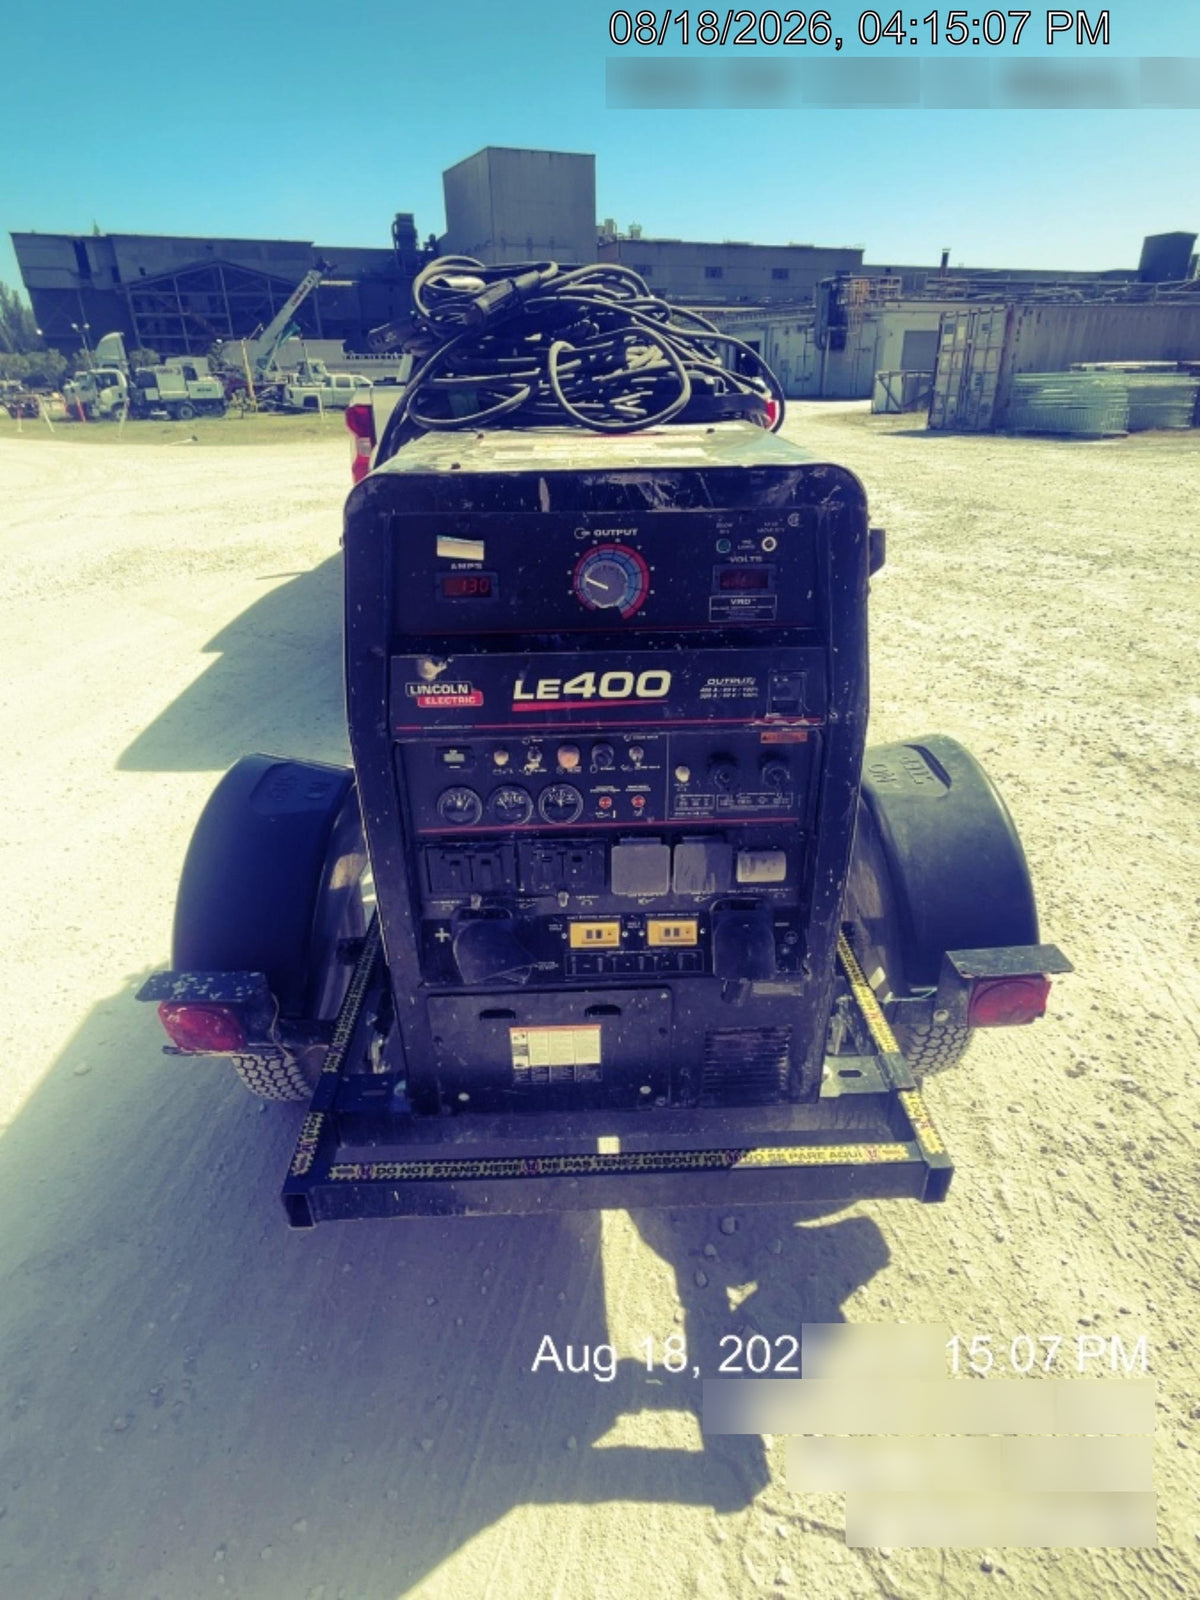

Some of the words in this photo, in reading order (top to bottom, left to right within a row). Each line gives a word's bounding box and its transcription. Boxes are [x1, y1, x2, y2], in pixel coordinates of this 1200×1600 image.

[593, 529, 638, 537] OUTPUT
[409, 683, 469, 695] LINCOLN
[512, 669, 673, 700] LE400
[425, 695, 477, 706] ELECTRIC
[375, 1167, 398, 1175] DO
[399, 1166, 431, 1175] NOT
[432, 1164, 482, 1174] STAND
